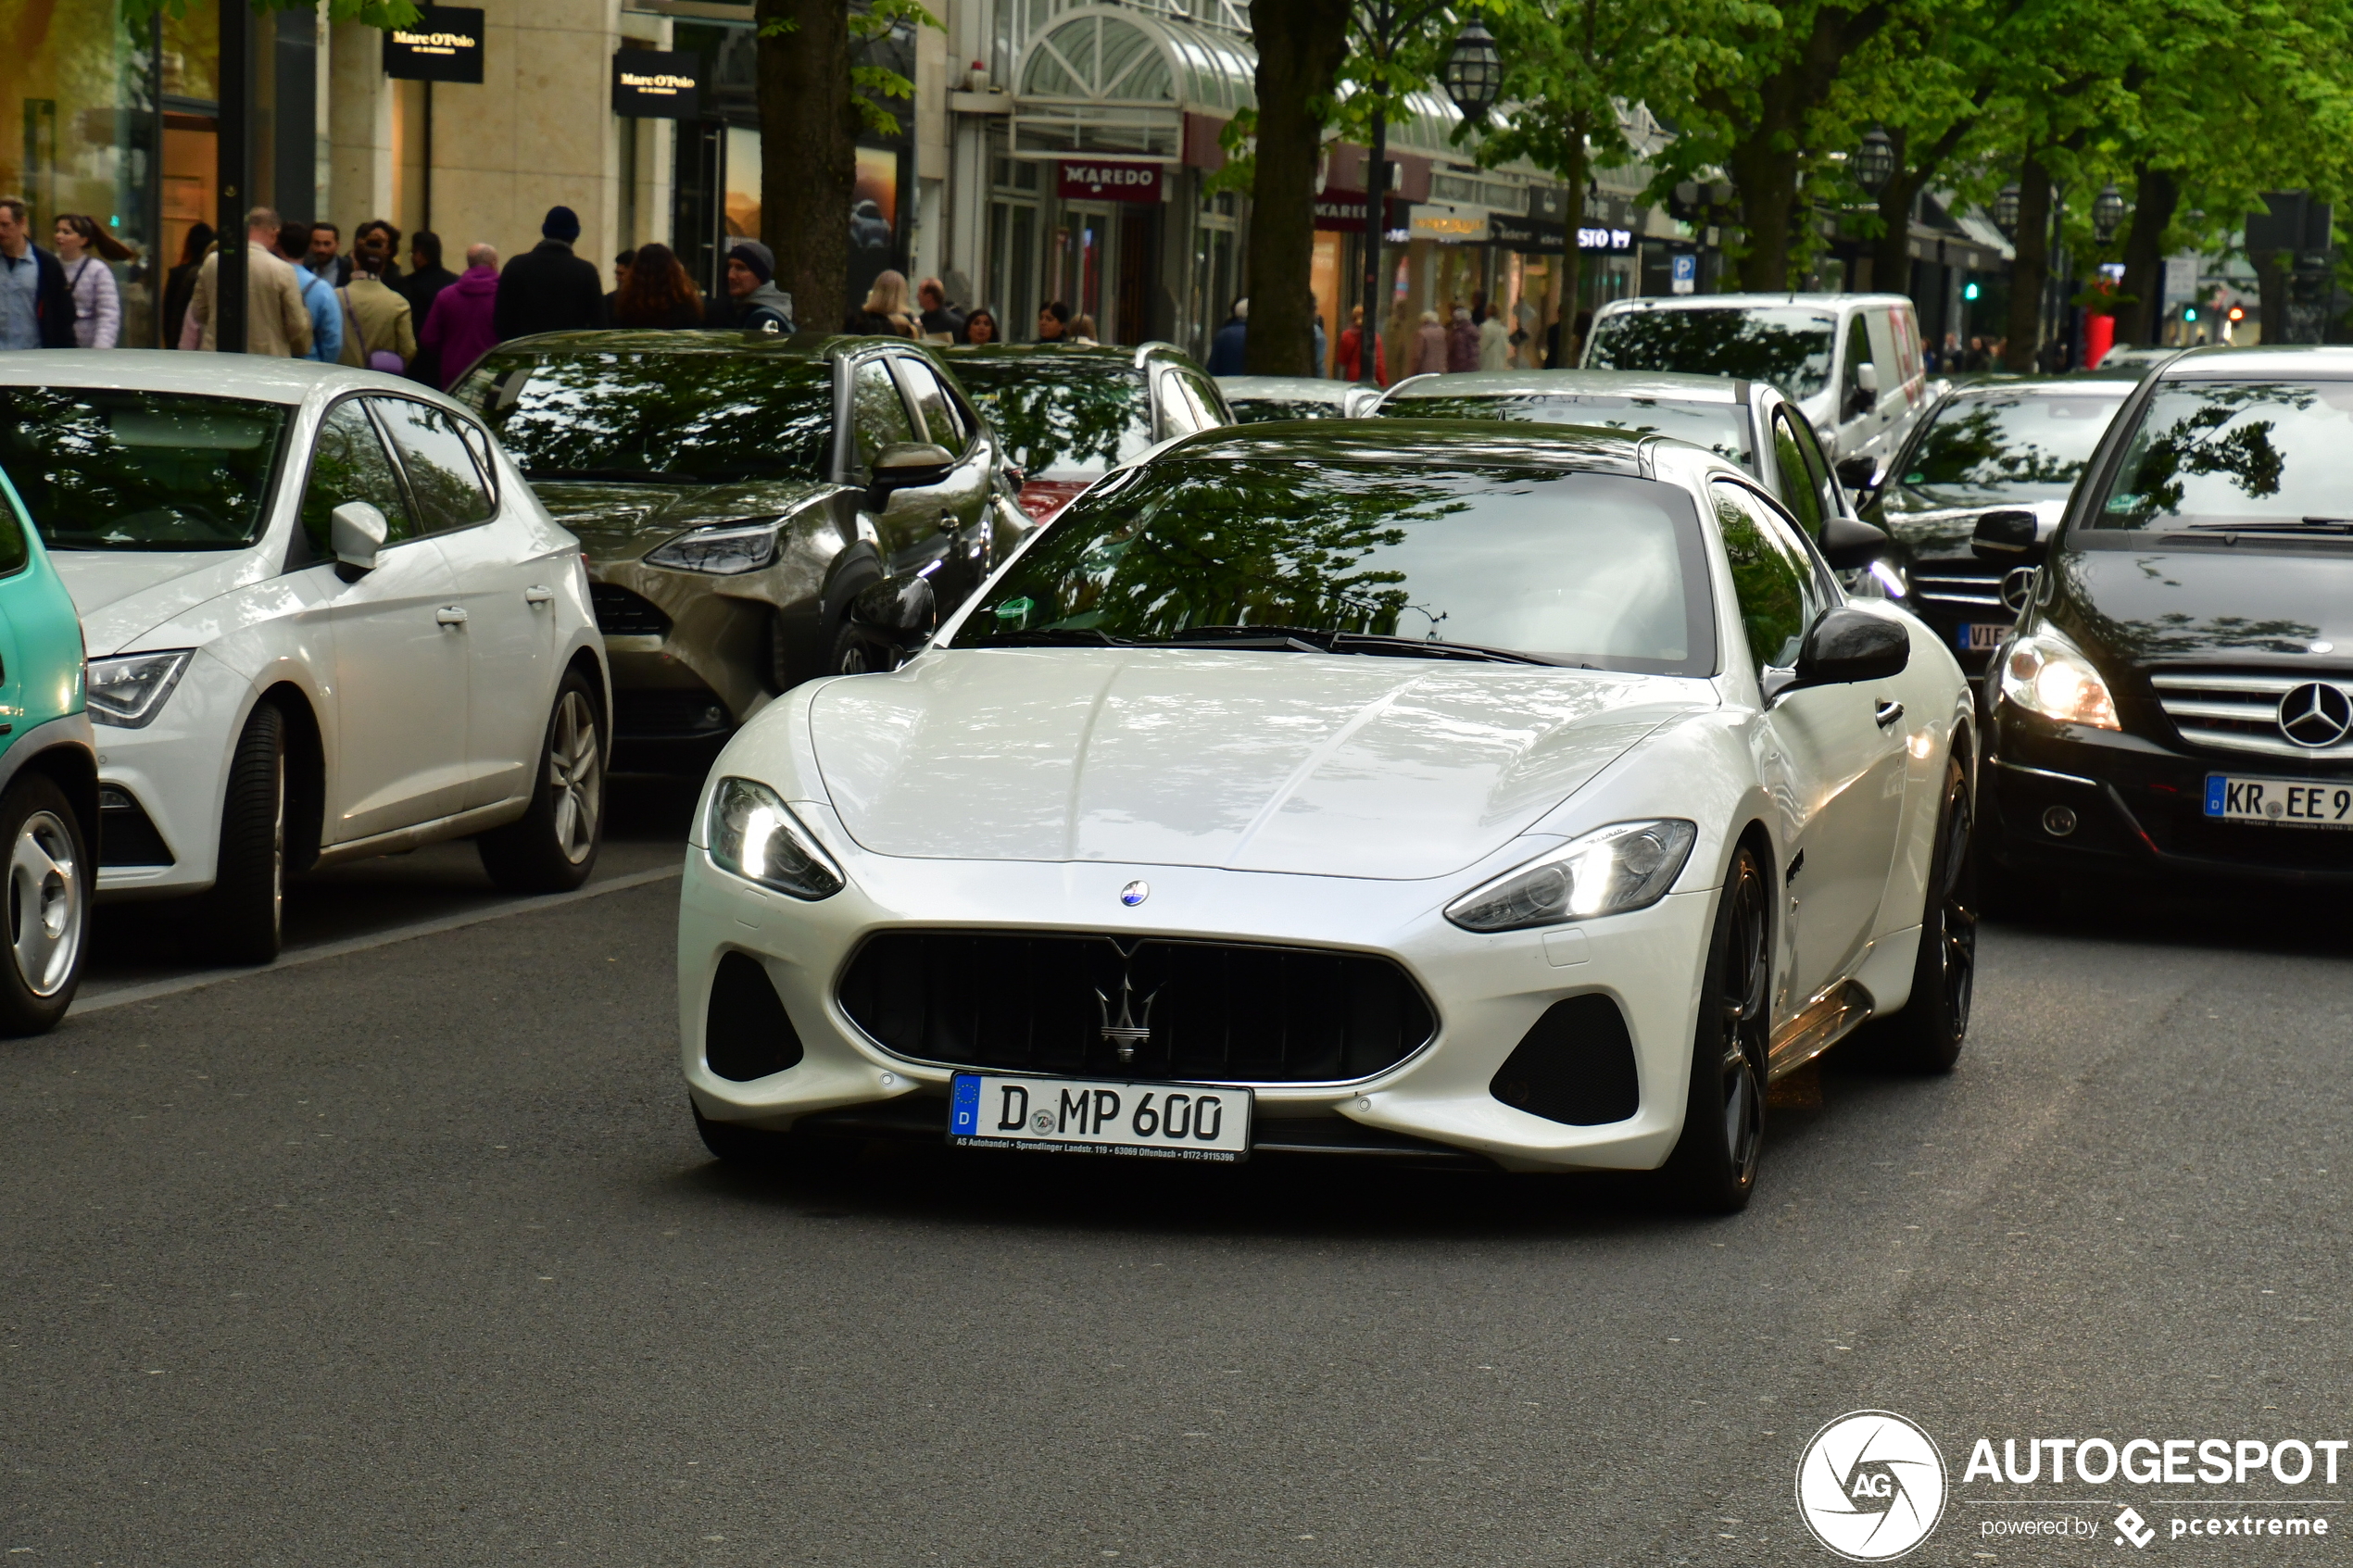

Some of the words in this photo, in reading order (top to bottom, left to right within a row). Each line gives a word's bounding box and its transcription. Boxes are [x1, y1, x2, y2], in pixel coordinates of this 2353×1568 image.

[393, 31, 430, 44] Marc
[621, 73, 654, 86] Marc
[1064, 166, 1153, 185] MAREDO
[2226, 783, 2264, 814] KR
[2287, 787, 2325, 818] EE
[958, 1111, 970, 1125] D
[998, 1085, 1029, 1130] D
[1058, 1088, 1121, 1135] MP
[1132, 1092, 1223, 1141] 600
[957, 1137, 966, 1146] AS
[968, 1138, 1009, 1148] Autohandel
[1016, 1140, 1063, 1152] Sprendlinger
[1064, 1144, 1093, 1153] Landstr.
[1095, 1146, 1107, 1154] 119
[1114, 1147, 1138, 1156] 63069
[1139, 1148, 1176, 1158] Offenbach
